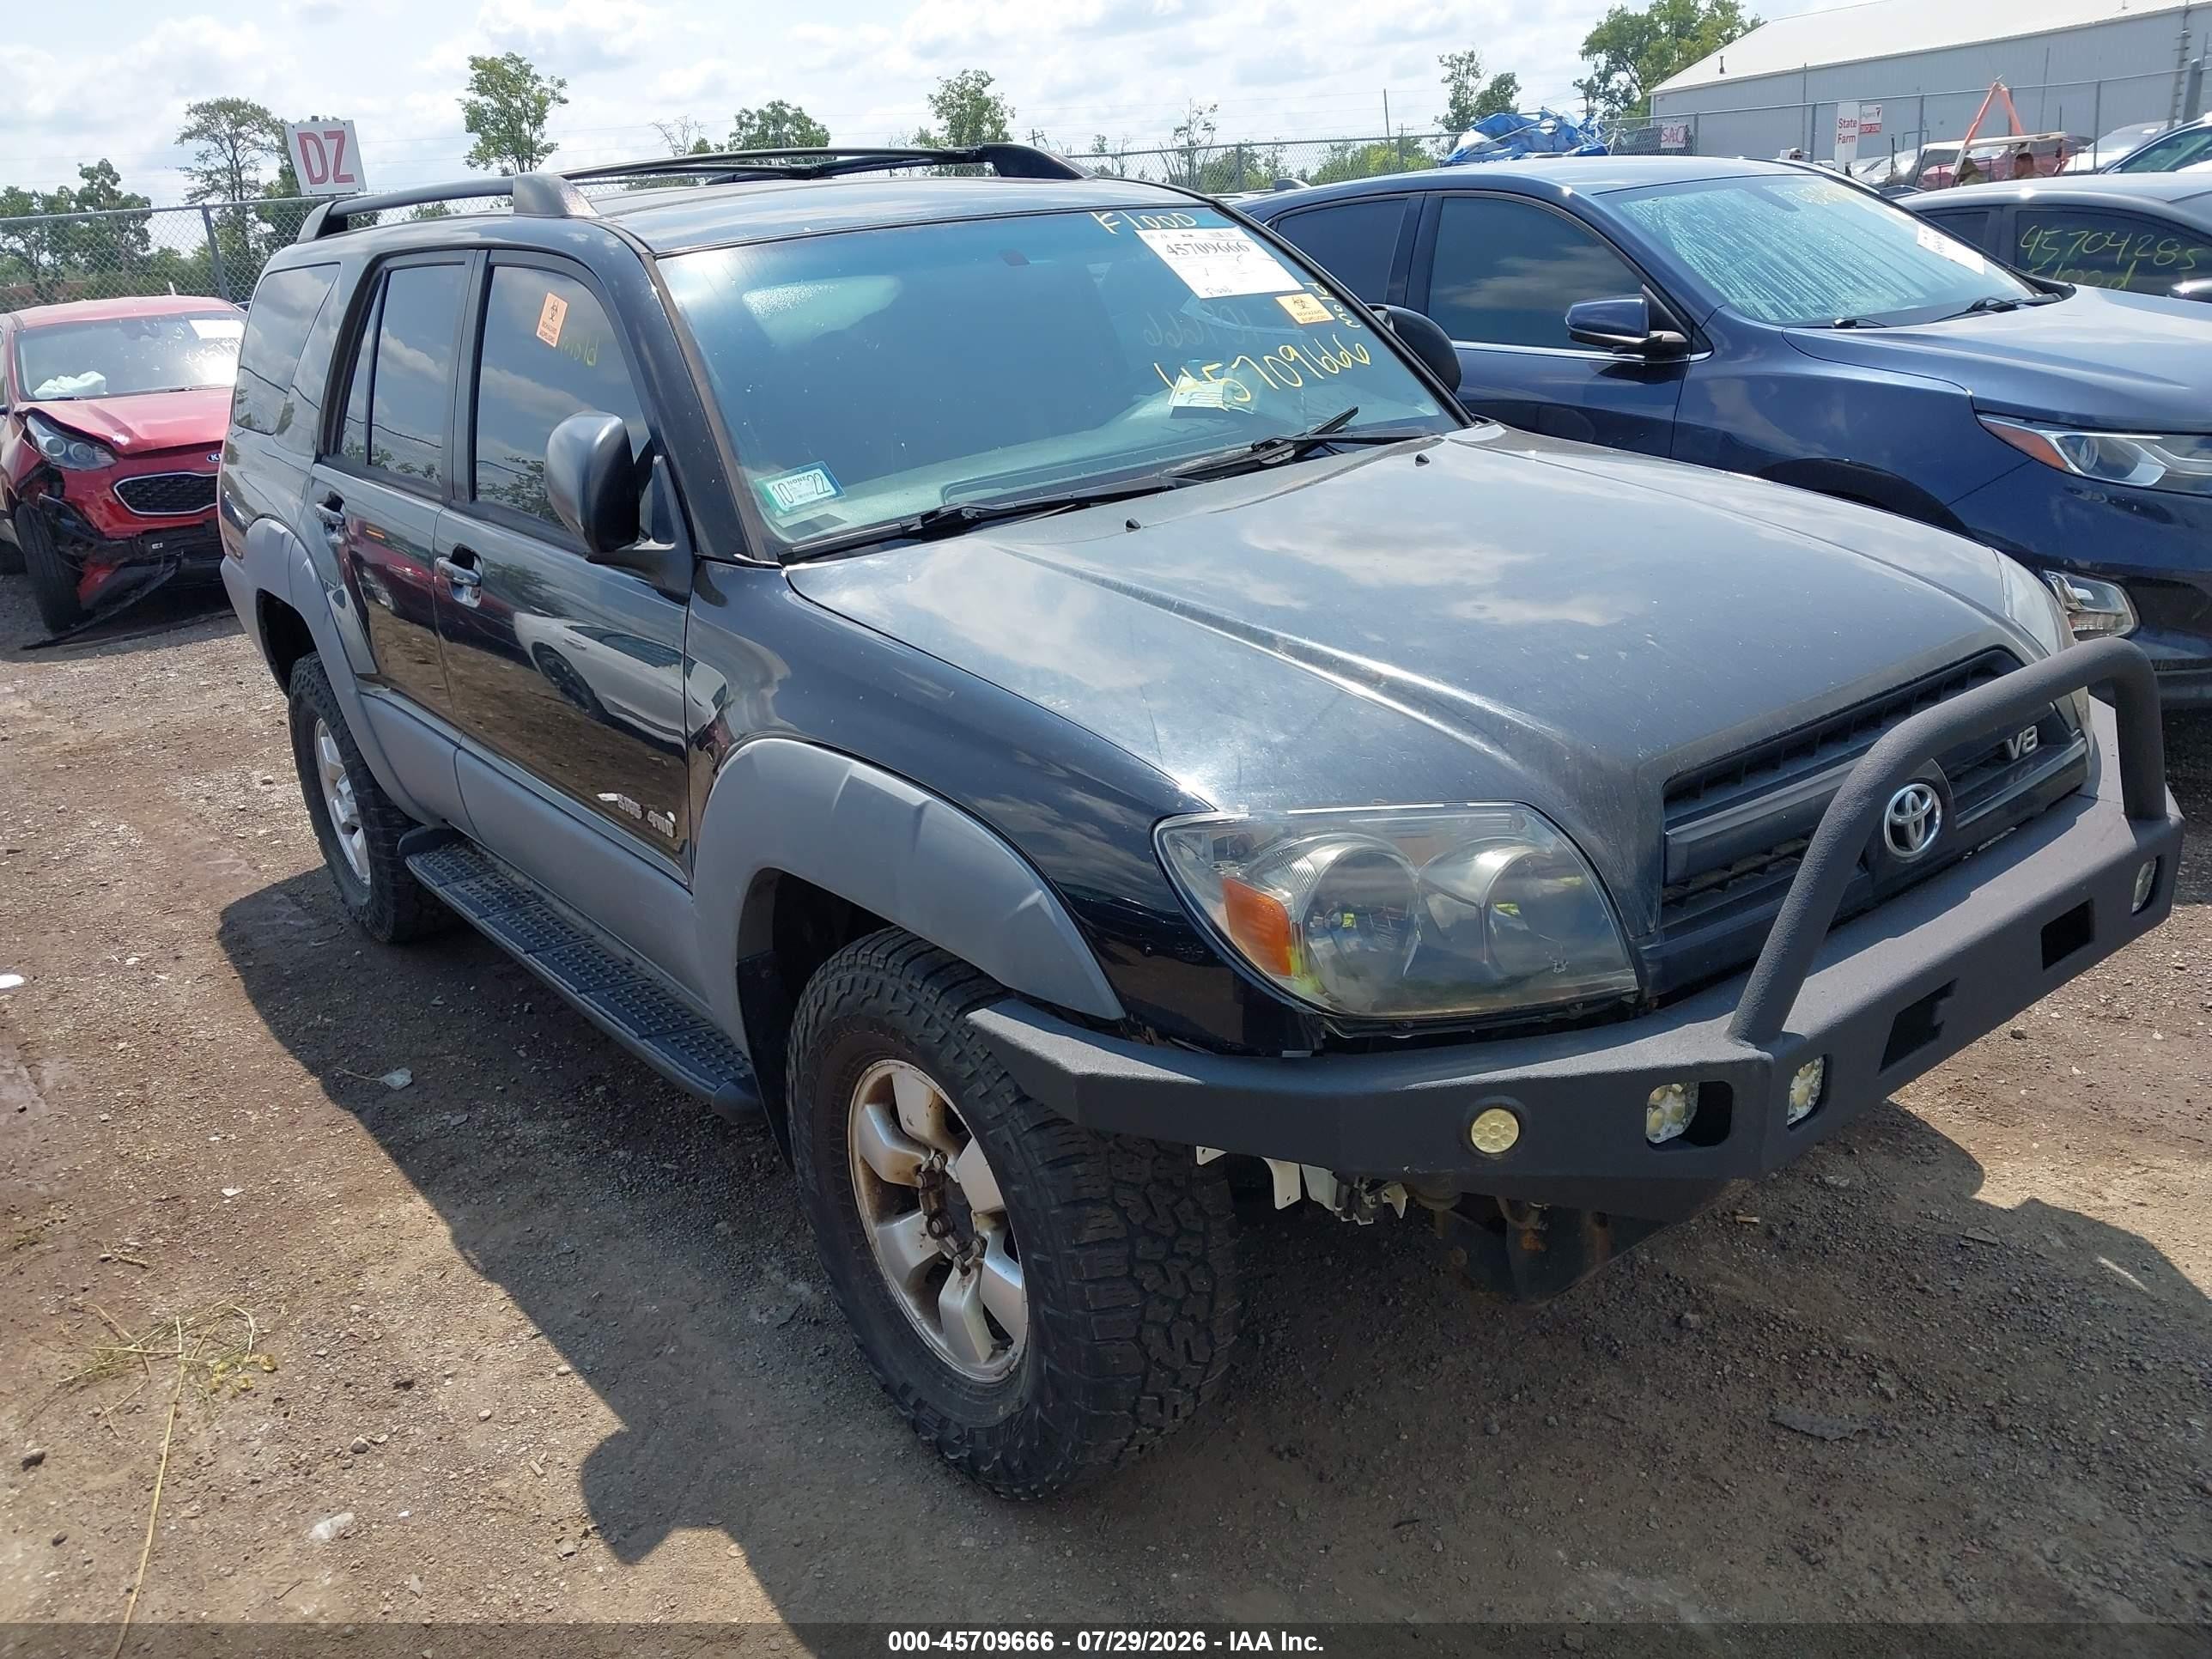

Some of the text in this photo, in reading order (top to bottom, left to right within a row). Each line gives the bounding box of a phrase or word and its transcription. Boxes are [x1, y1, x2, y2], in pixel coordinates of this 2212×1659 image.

[1837, 133, 1856, 144] Farm
[1838, 118, 1857, 129] State
[297, 130, 355, 185] DZ
[1166, 240, 1251, 257] 45709666
[2020, 225, 2205, 270] 45704285
[772, 483, 794, 507] 10
[806, 472, 831, 496] 22
[2006, 725, 2039, 760] V8
